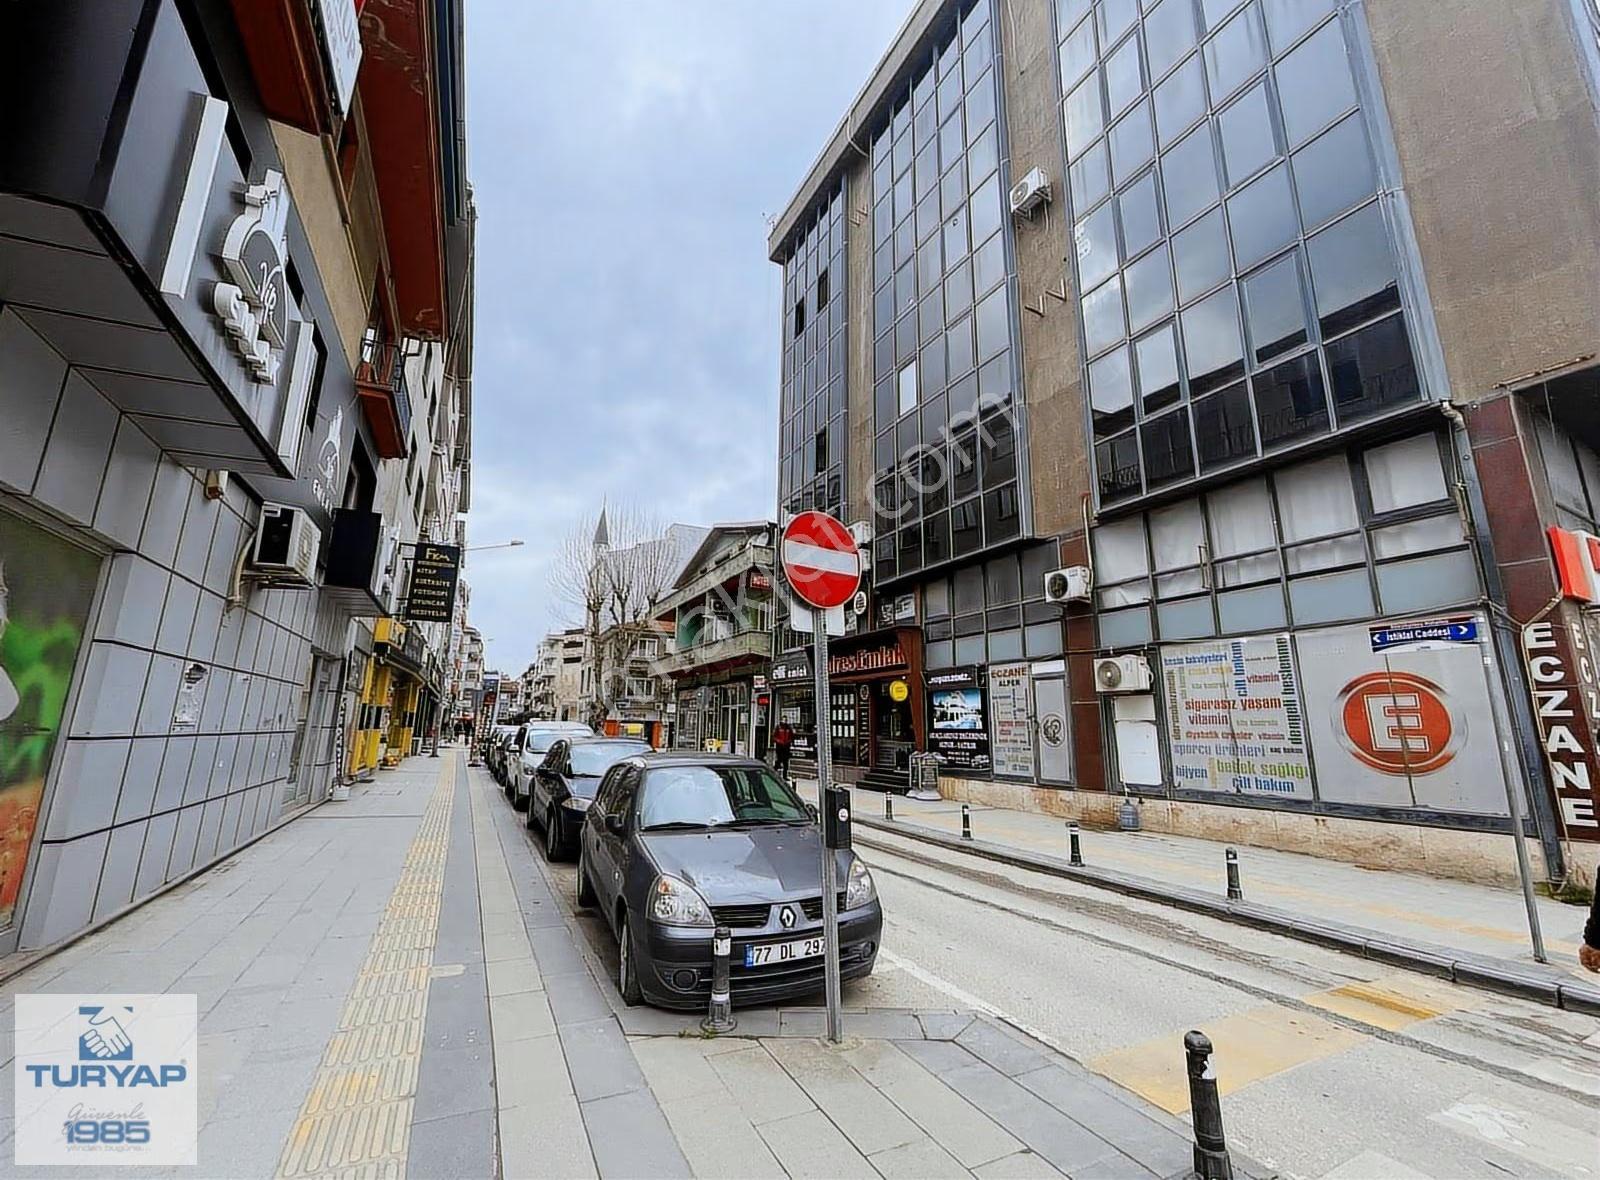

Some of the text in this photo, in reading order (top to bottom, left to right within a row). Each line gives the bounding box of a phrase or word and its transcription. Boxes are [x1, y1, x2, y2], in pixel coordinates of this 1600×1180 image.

[991, 666, 1027, 679] ECZANE
[1246, 672, 1280, 684] vitamin
[1185, 697, 1282, 712] sigarasız yaşam
[1188, 714, 1229, 726] vitamin
[1523, 622, 1598, 827] ECZANE
[1173, 744, 1212, 756] sporcu
[1175, 765, 1208, 779] hijyen
[1254, 776, 1295, 793] bakım
[755, 947, 772, 963] 77
[780, 943, 796, 960] DL
